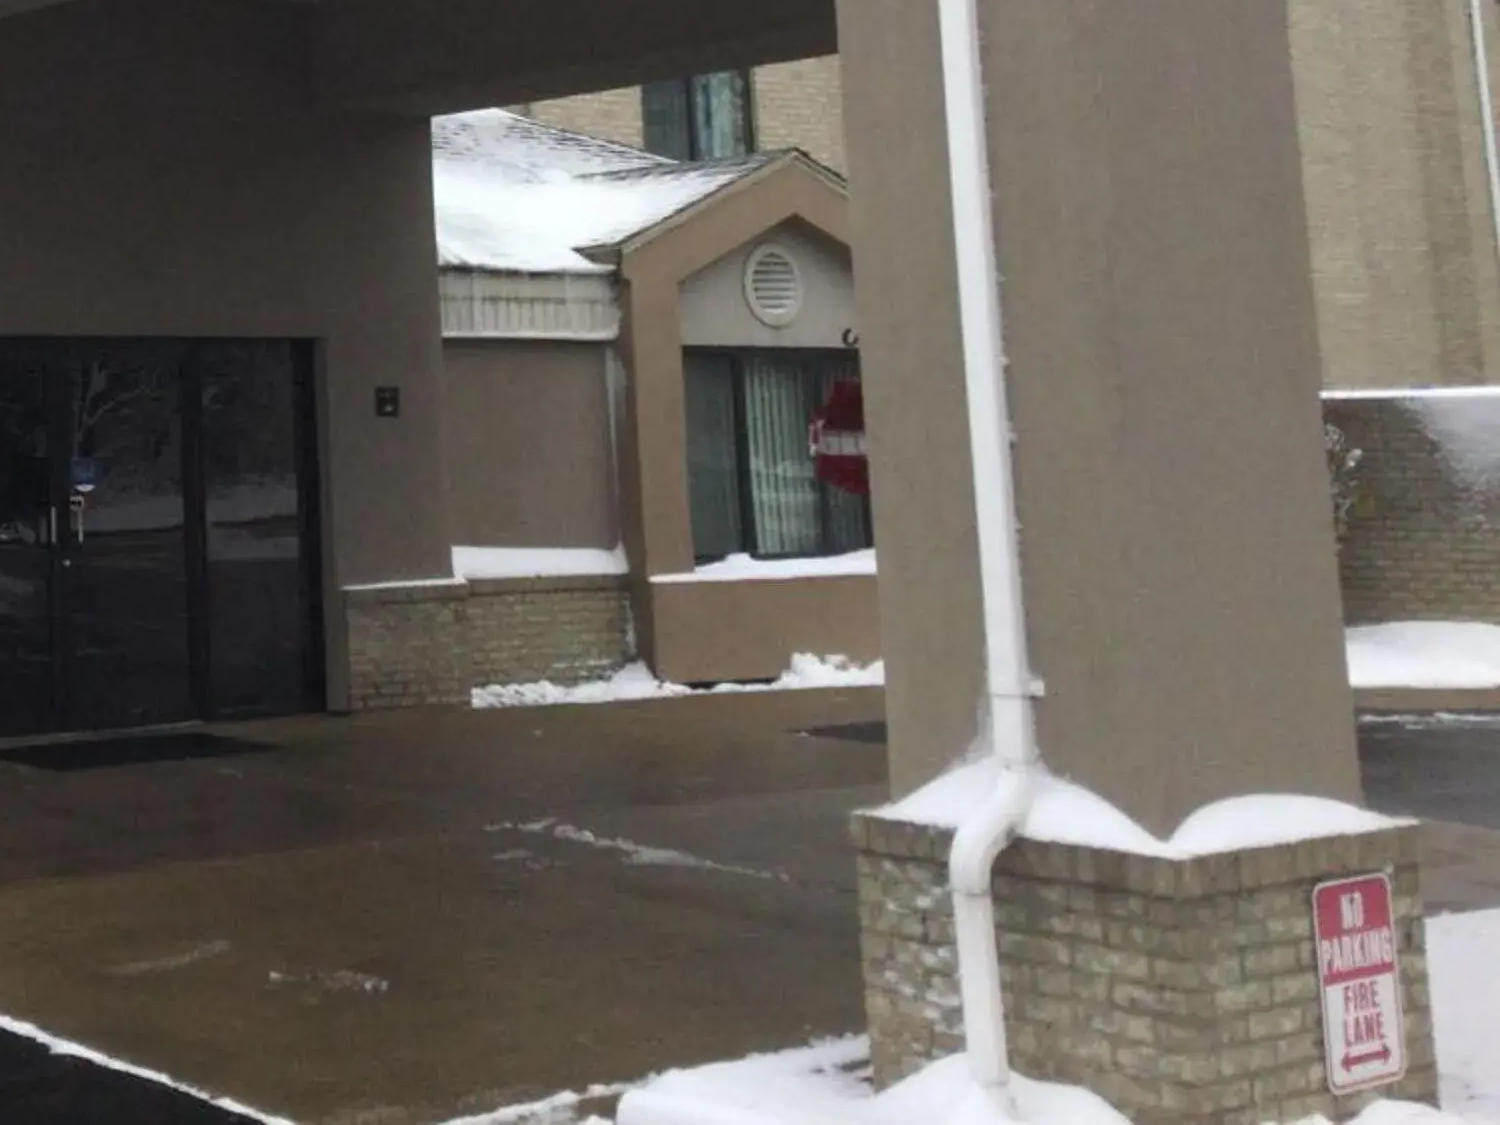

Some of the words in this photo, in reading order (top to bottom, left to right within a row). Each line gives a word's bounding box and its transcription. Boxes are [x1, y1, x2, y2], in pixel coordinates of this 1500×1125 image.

[1321, 926, 1393, 976] PARKING
[1343, 981, 1380, 1013] FIRE
[1344, 1012, 1386, 1048] LANE
